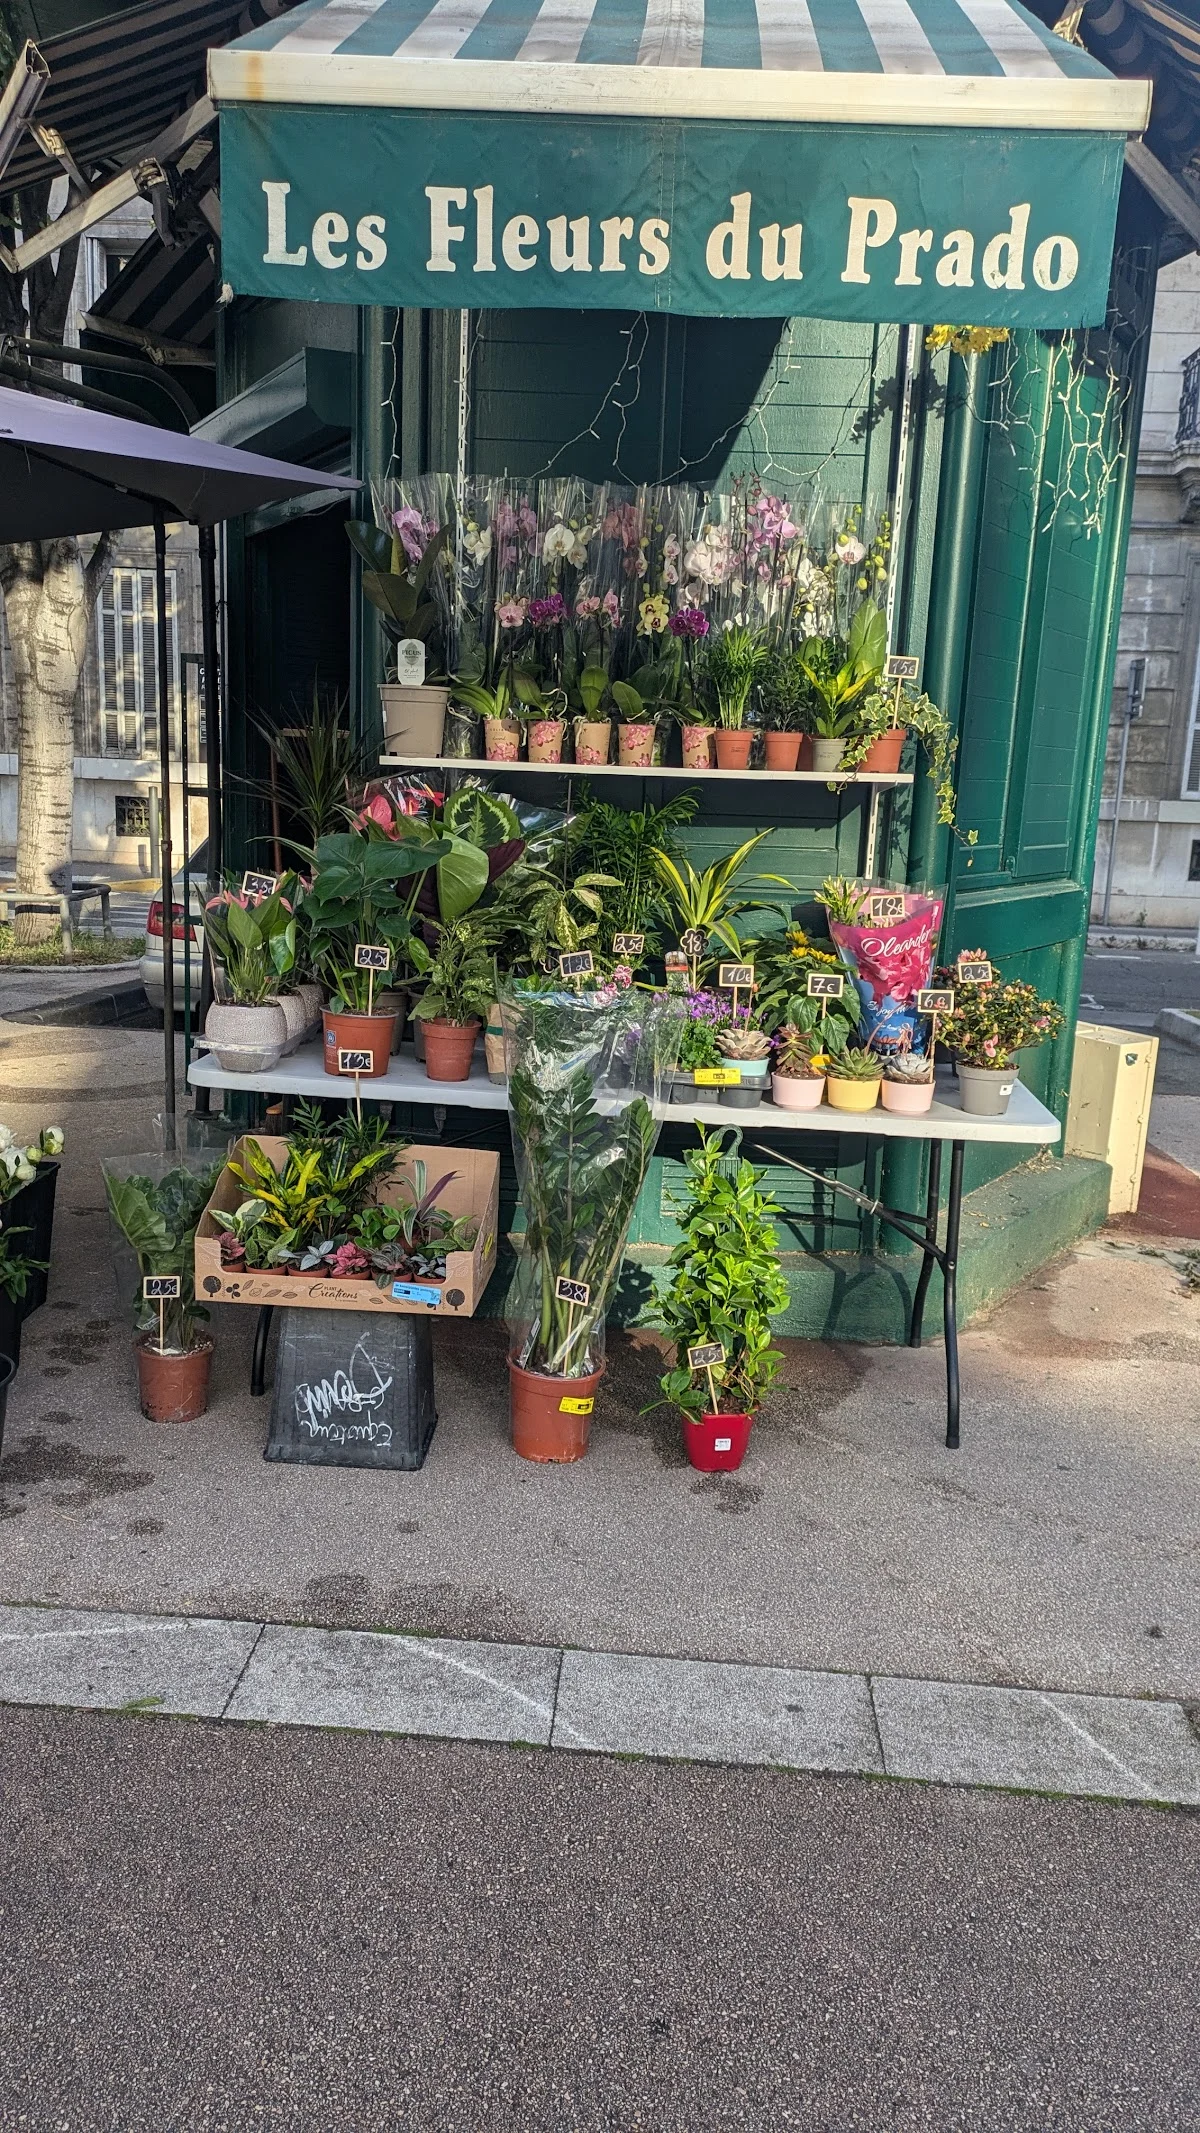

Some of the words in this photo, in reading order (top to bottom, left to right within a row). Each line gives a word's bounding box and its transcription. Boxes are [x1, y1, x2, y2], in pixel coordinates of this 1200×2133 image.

[262, 181, 388, 271] Les
[425, 185, 670, 275] Fleurs
[706, 191, 803, 281] du
[840, 196, 1079, 291] Prado
[893, 660, 915, 675] 15€
[615, 936, 642, 951] 25€
[860, 924, 930, 957] Oleander
[813, 977, 835, 993] 7€
[151, 1279, 177, 1296] 25€
[308, 1282, 358, 1301] Creations
